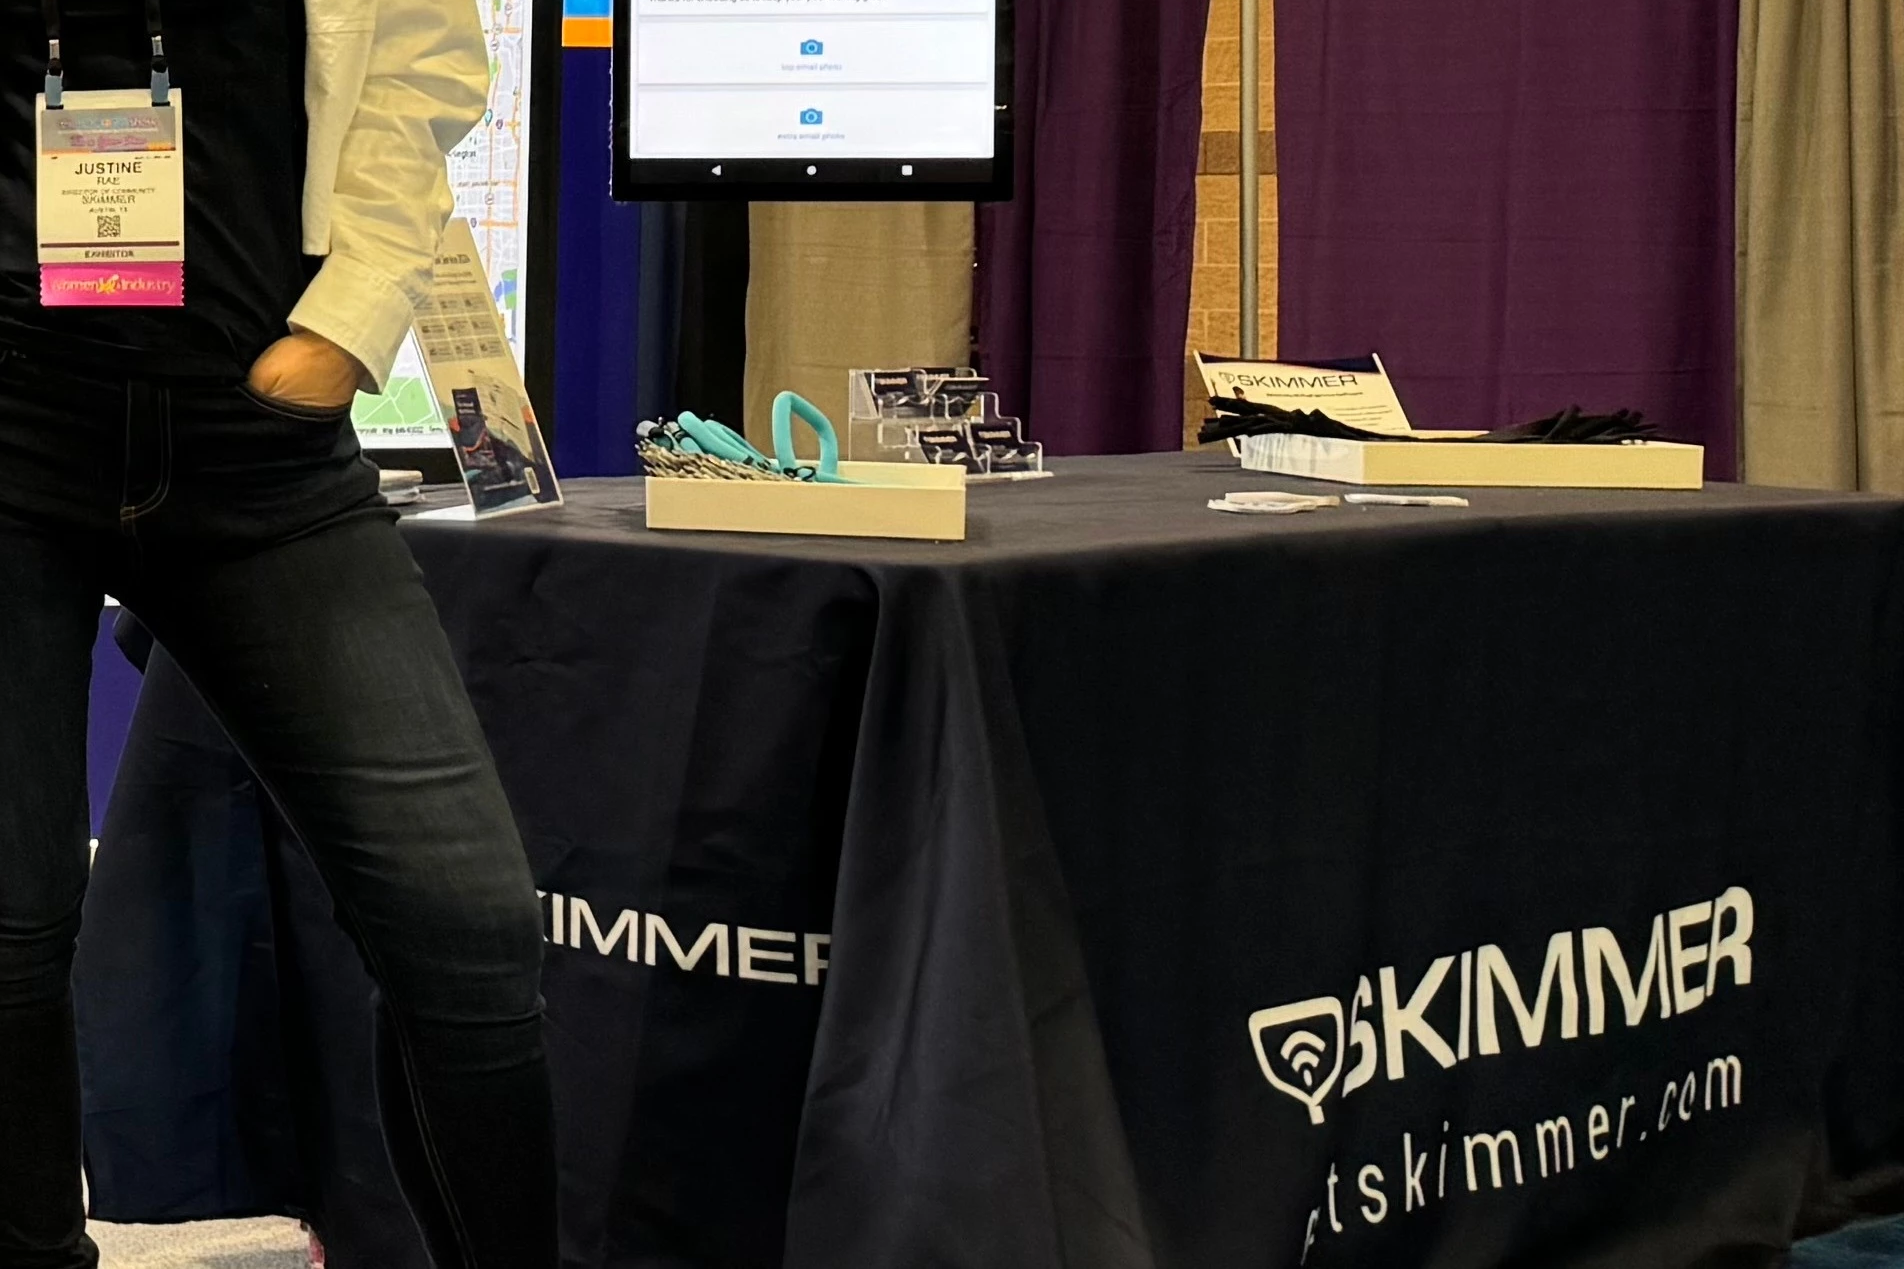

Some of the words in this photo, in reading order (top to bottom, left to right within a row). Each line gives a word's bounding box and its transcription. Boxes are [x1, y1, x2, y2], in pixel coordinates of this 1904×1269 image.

[74, 161, 143, 176] JUSTINE
[84, 249, 135, 259] EXHIBITOR
[119, 278, 175, 295] Industry
[1237, 373, 1359, 389] SKIMMER
[1341, 885, 1754, 1098] SKIMMER
